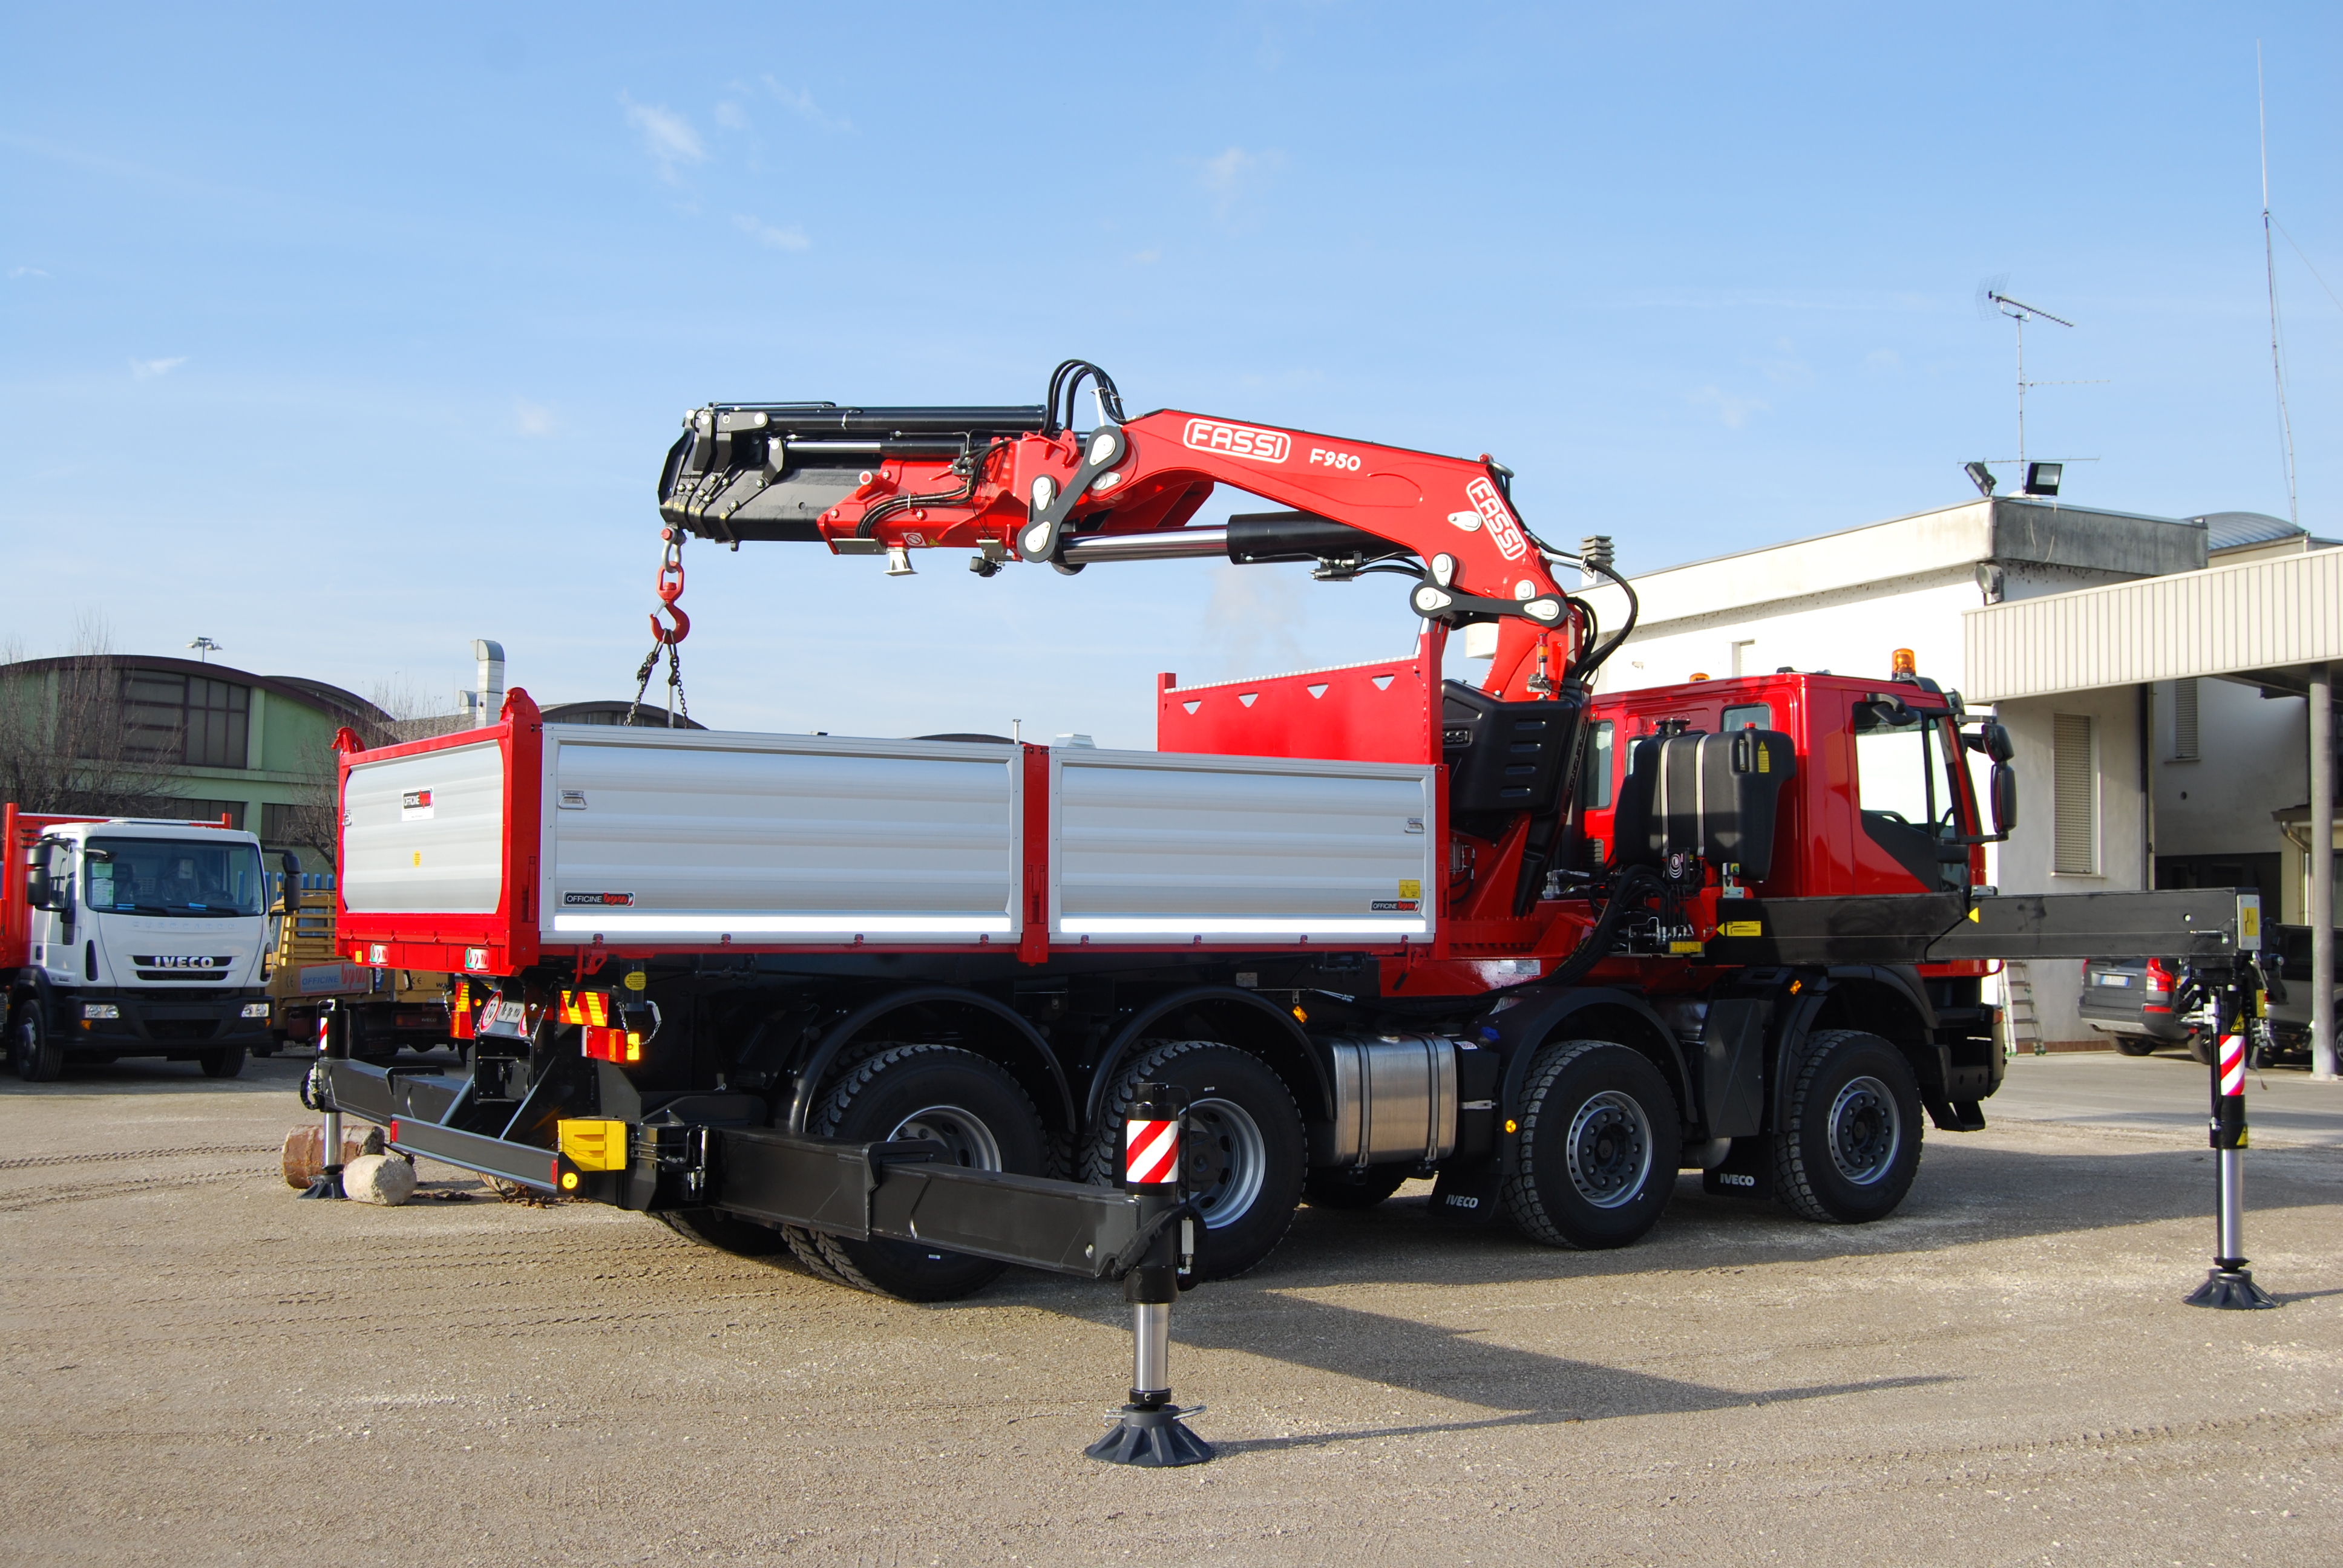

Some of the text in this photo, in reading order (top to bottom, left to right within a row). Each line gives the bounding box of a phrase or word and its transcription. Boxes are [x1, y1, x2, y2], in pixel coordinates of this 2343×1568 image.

[1191, 423, 1283, 459] FASSI
[1309, 448, 1361, 471] F950
[1471, 482, 1522, 555] FASSI
[603, 892, 628, 906] bpm
[154, 956, 215, 969] IVECO
[302, 975, 339, 985] OFFICINE
[1720, 1173, 1755, 1186] IVECO
[1446, 1194, 1479, 1208] IVECO
